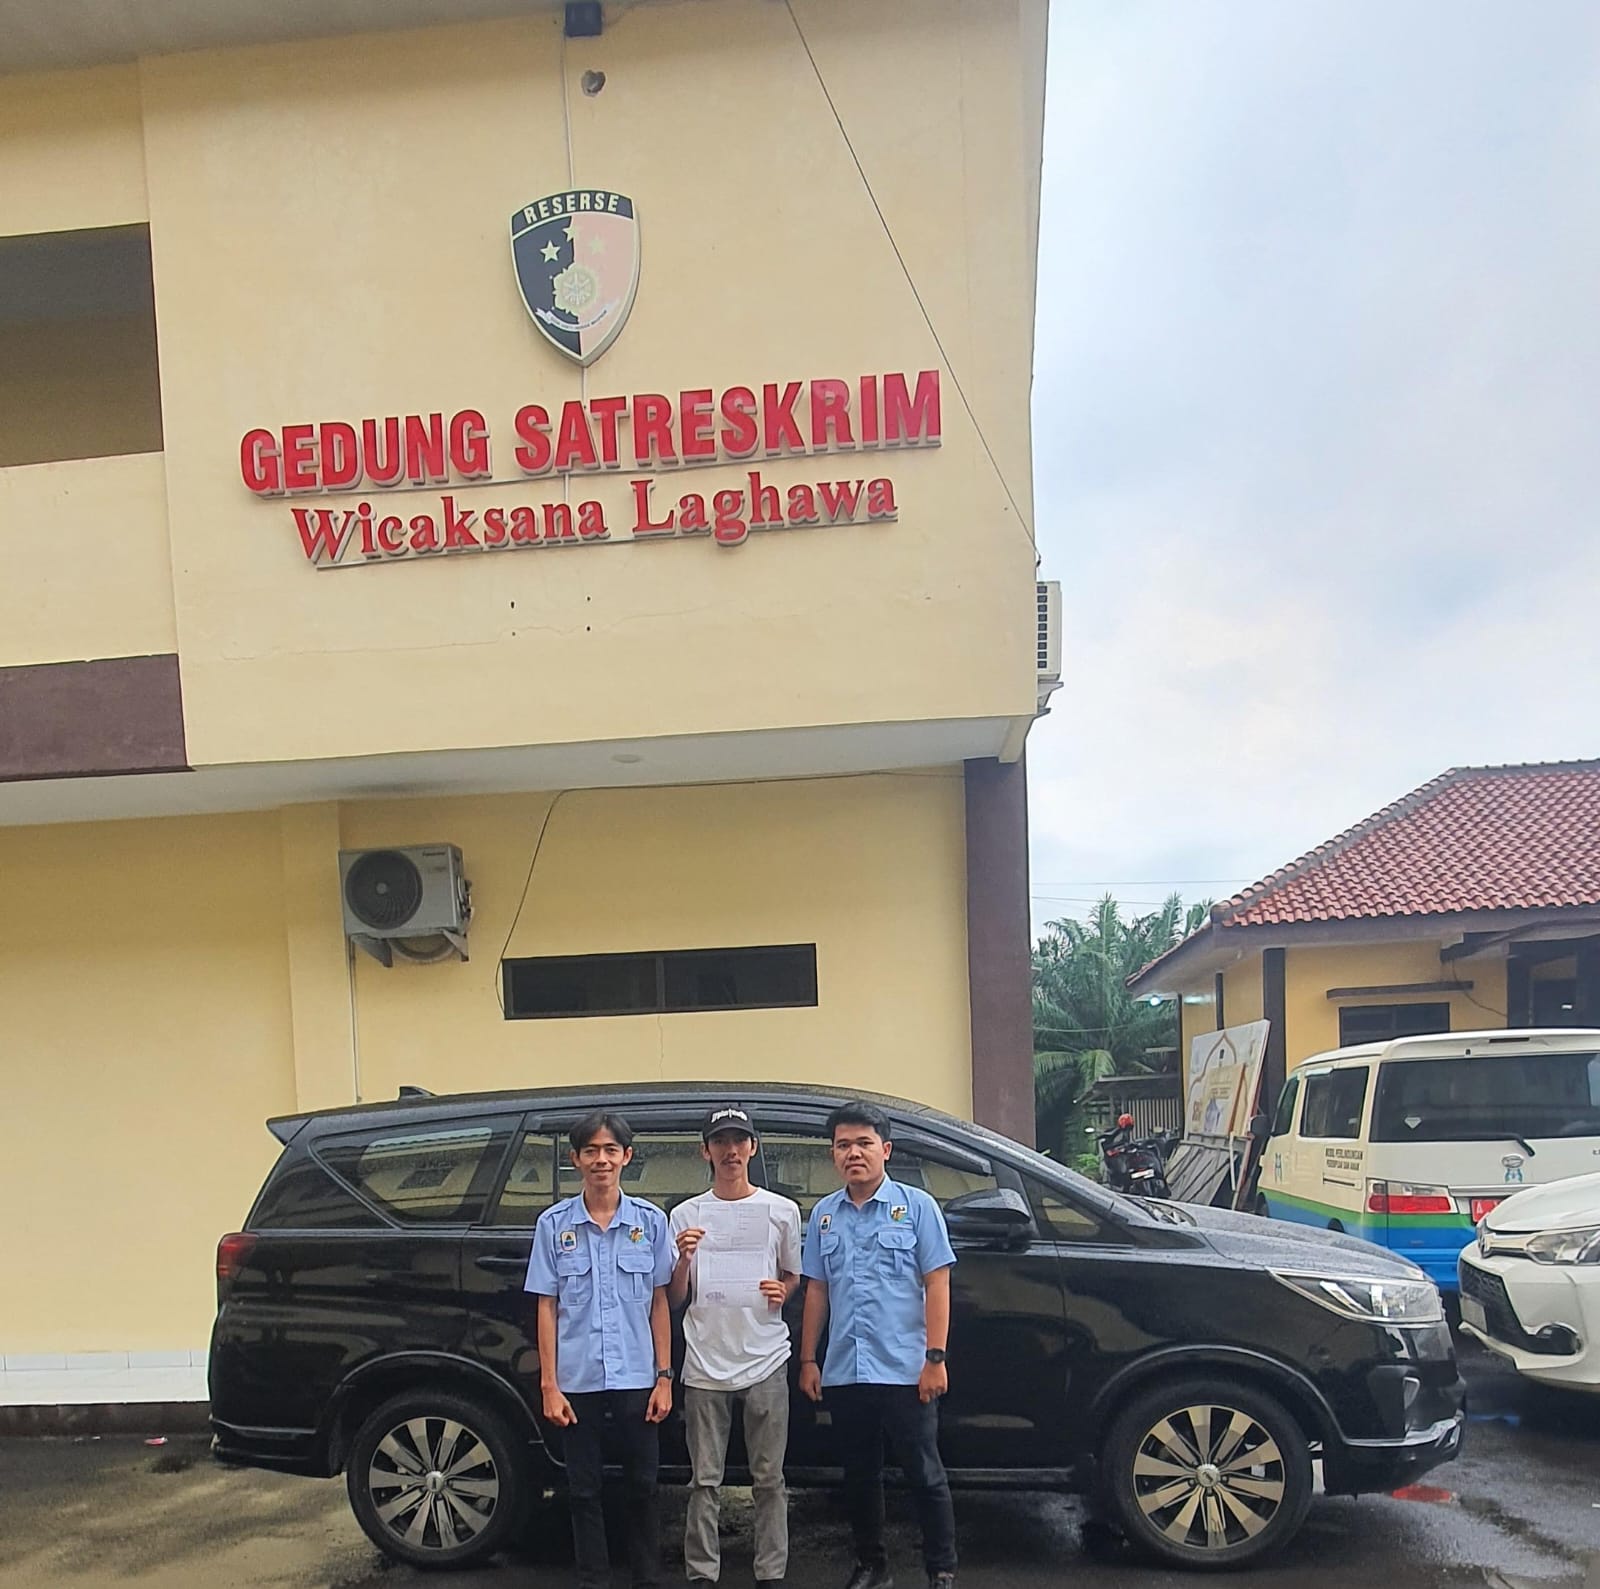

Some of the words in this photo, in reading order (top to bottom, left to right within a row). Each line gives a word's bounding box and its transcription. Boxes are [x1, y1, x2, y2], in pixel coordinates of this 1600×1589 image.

[524, 192, 620, 224] RESERSE
[240, 409, 491, 495] GEDUNG
[514, 370, 942, 474] SATRESKRIM
[291, 496, 611, 563] Wicaksana
[630, 471, 898, 545] Laghawa
